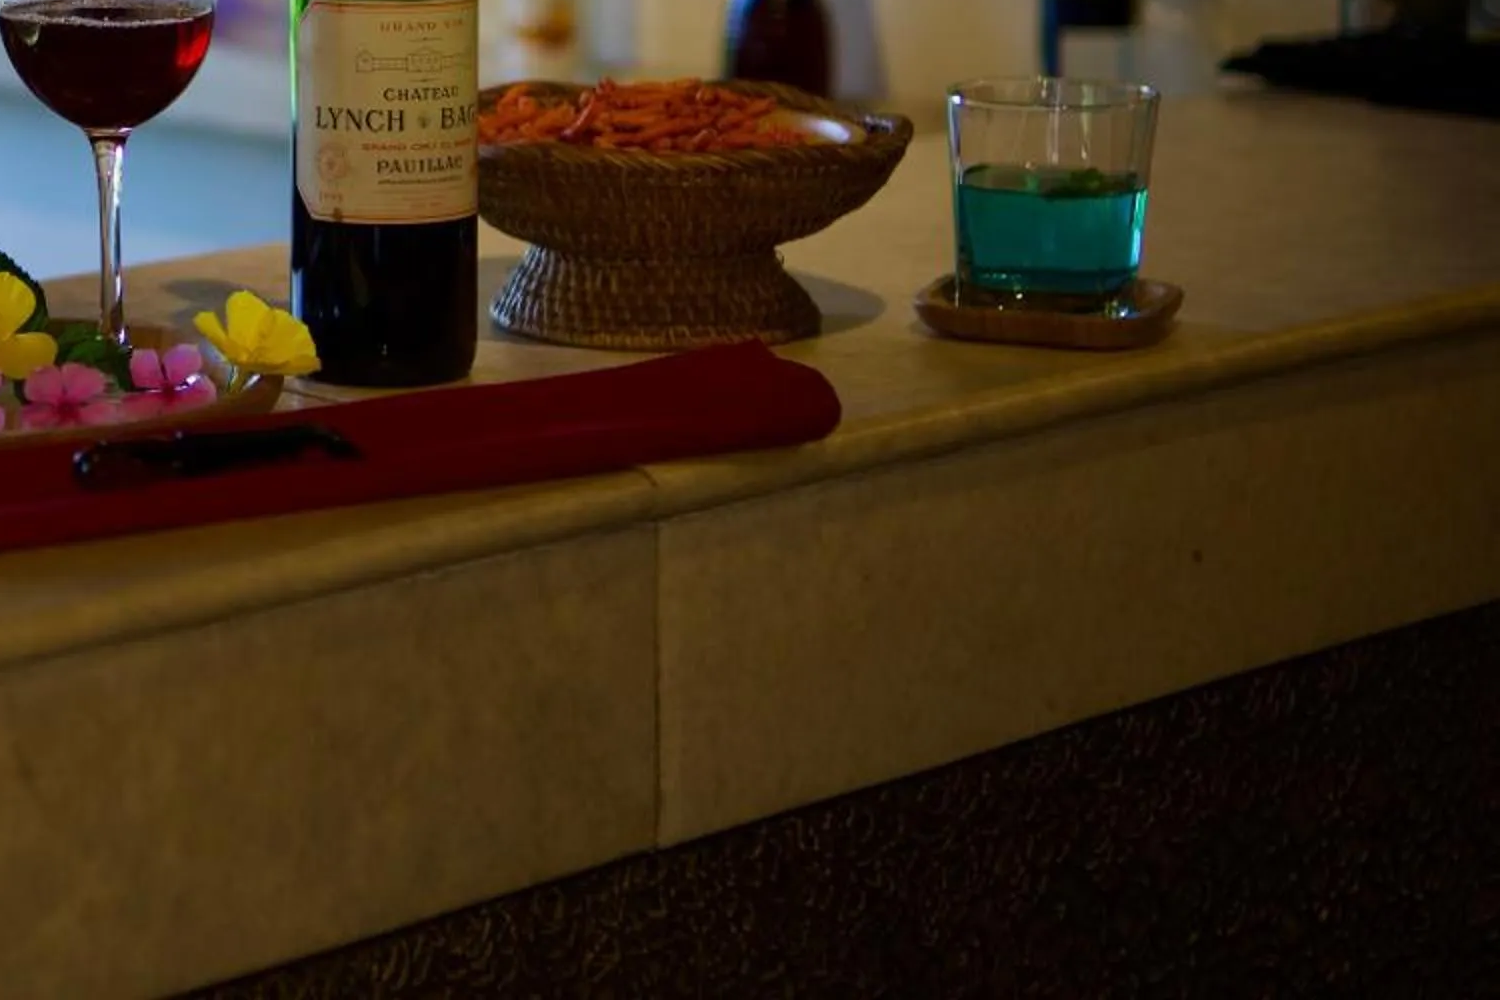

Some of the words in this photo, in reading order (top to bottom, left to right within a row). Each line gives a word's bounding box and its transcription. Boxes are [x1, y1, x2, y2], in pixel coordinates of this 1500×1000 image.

[383, 86, 460, 102] CHATEAU
[315, 105, 405, 133] LYNCH
[376, 155, 463, 175] PAUILLAC
